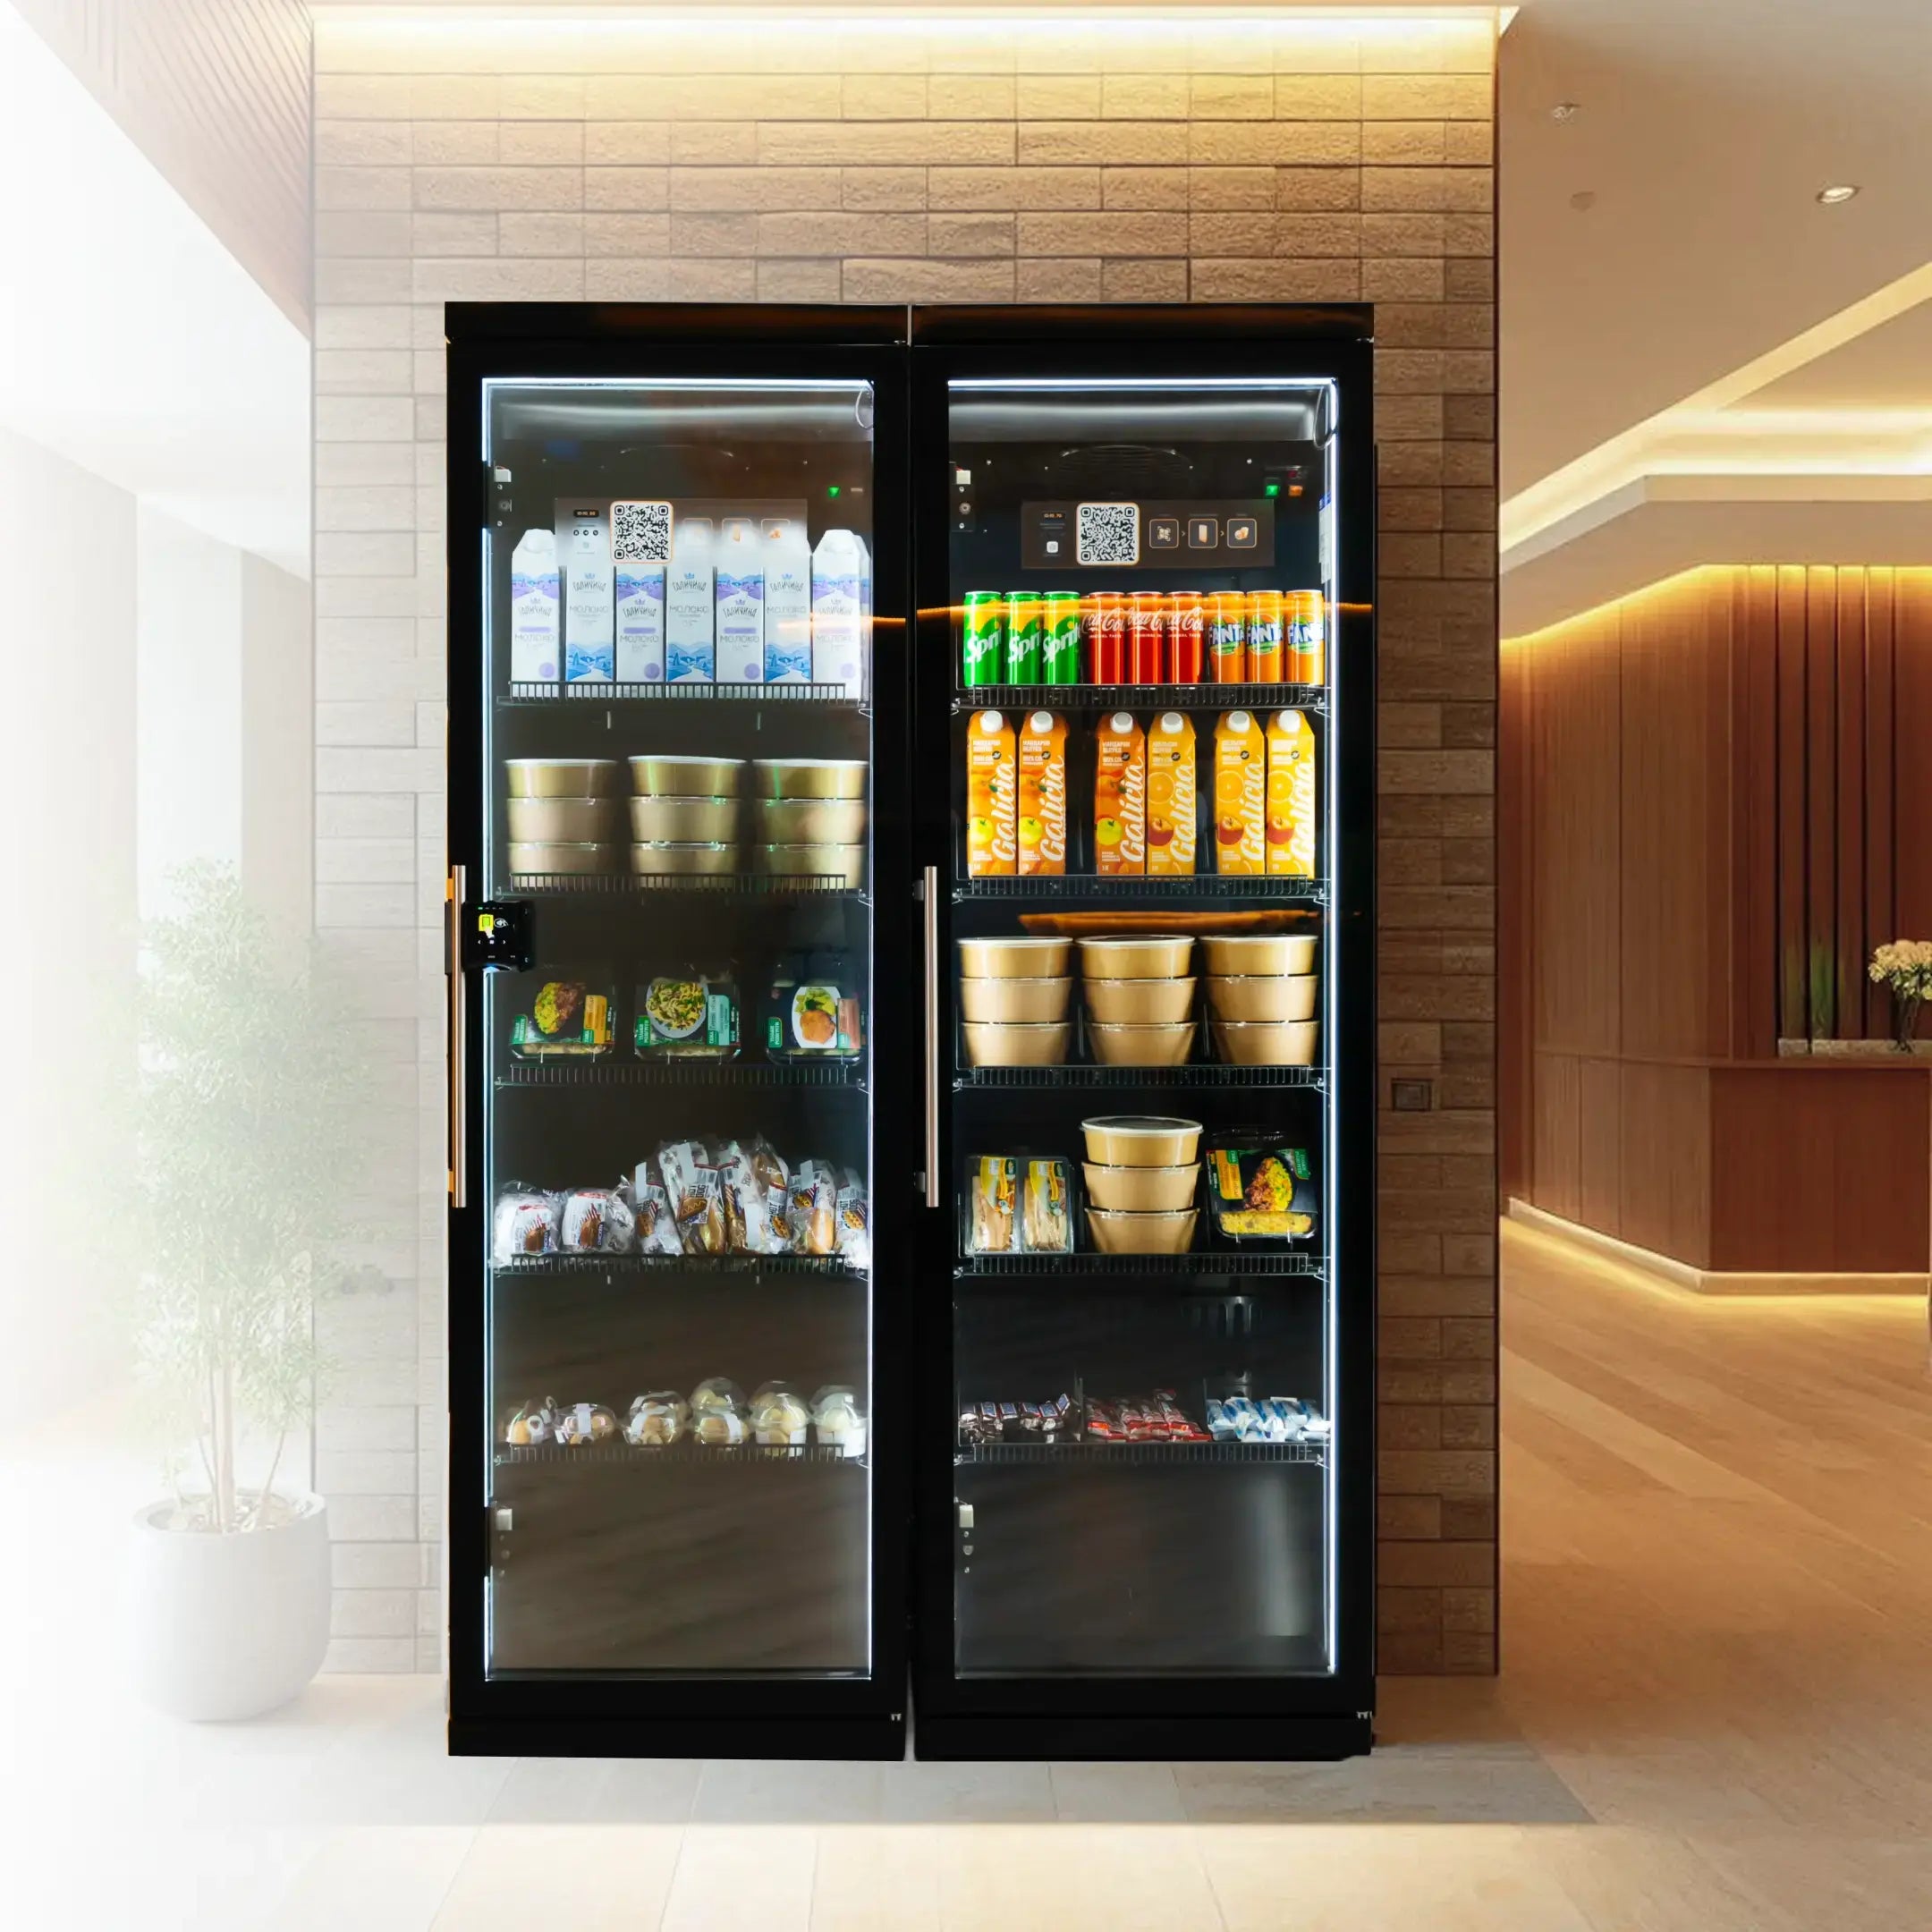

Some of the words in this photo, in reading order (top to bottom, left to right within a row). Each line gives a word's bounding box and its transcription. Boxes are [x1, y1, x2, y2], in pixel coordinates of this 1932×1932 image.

[572, 581, 606, 592] ГАЛИЧИНА
[672, 581, 707, 592] ГАЛИЧИНА
[770, 581, 804, 592] ГАЛИЧИНА
[570, 606, 608, 614] МОЛОКО
[623, 606, 657, 617] ГАЛИЧИНА
[670, 606, 709, 614] МОЛОКО
[723, 607, 758, 618] ГАЛИЧИНА
[767, 606, 807, 614] МОЛОКО
[514, 634, 555, 643] МОЛОКО
[620, 634, 659, 643] МОЛОКО
[720, 635, 759, 643] МОЛОКО
[991, 755, 1016, 861] Galicia
[1039, 755, 1065, 861] Galicia
[1119, 756, 1145, 862] Galicia
[1170, 756, 1197, 862] Galicia
[1239, 755, 1264, 860] Galicia
[1290, 755, 1315, 860] Galicia
[697, 1184, 706, 1197] DOG
[768, 1202, 778, 1216] HOT
[840, 1200, 849, 1210] HOT
